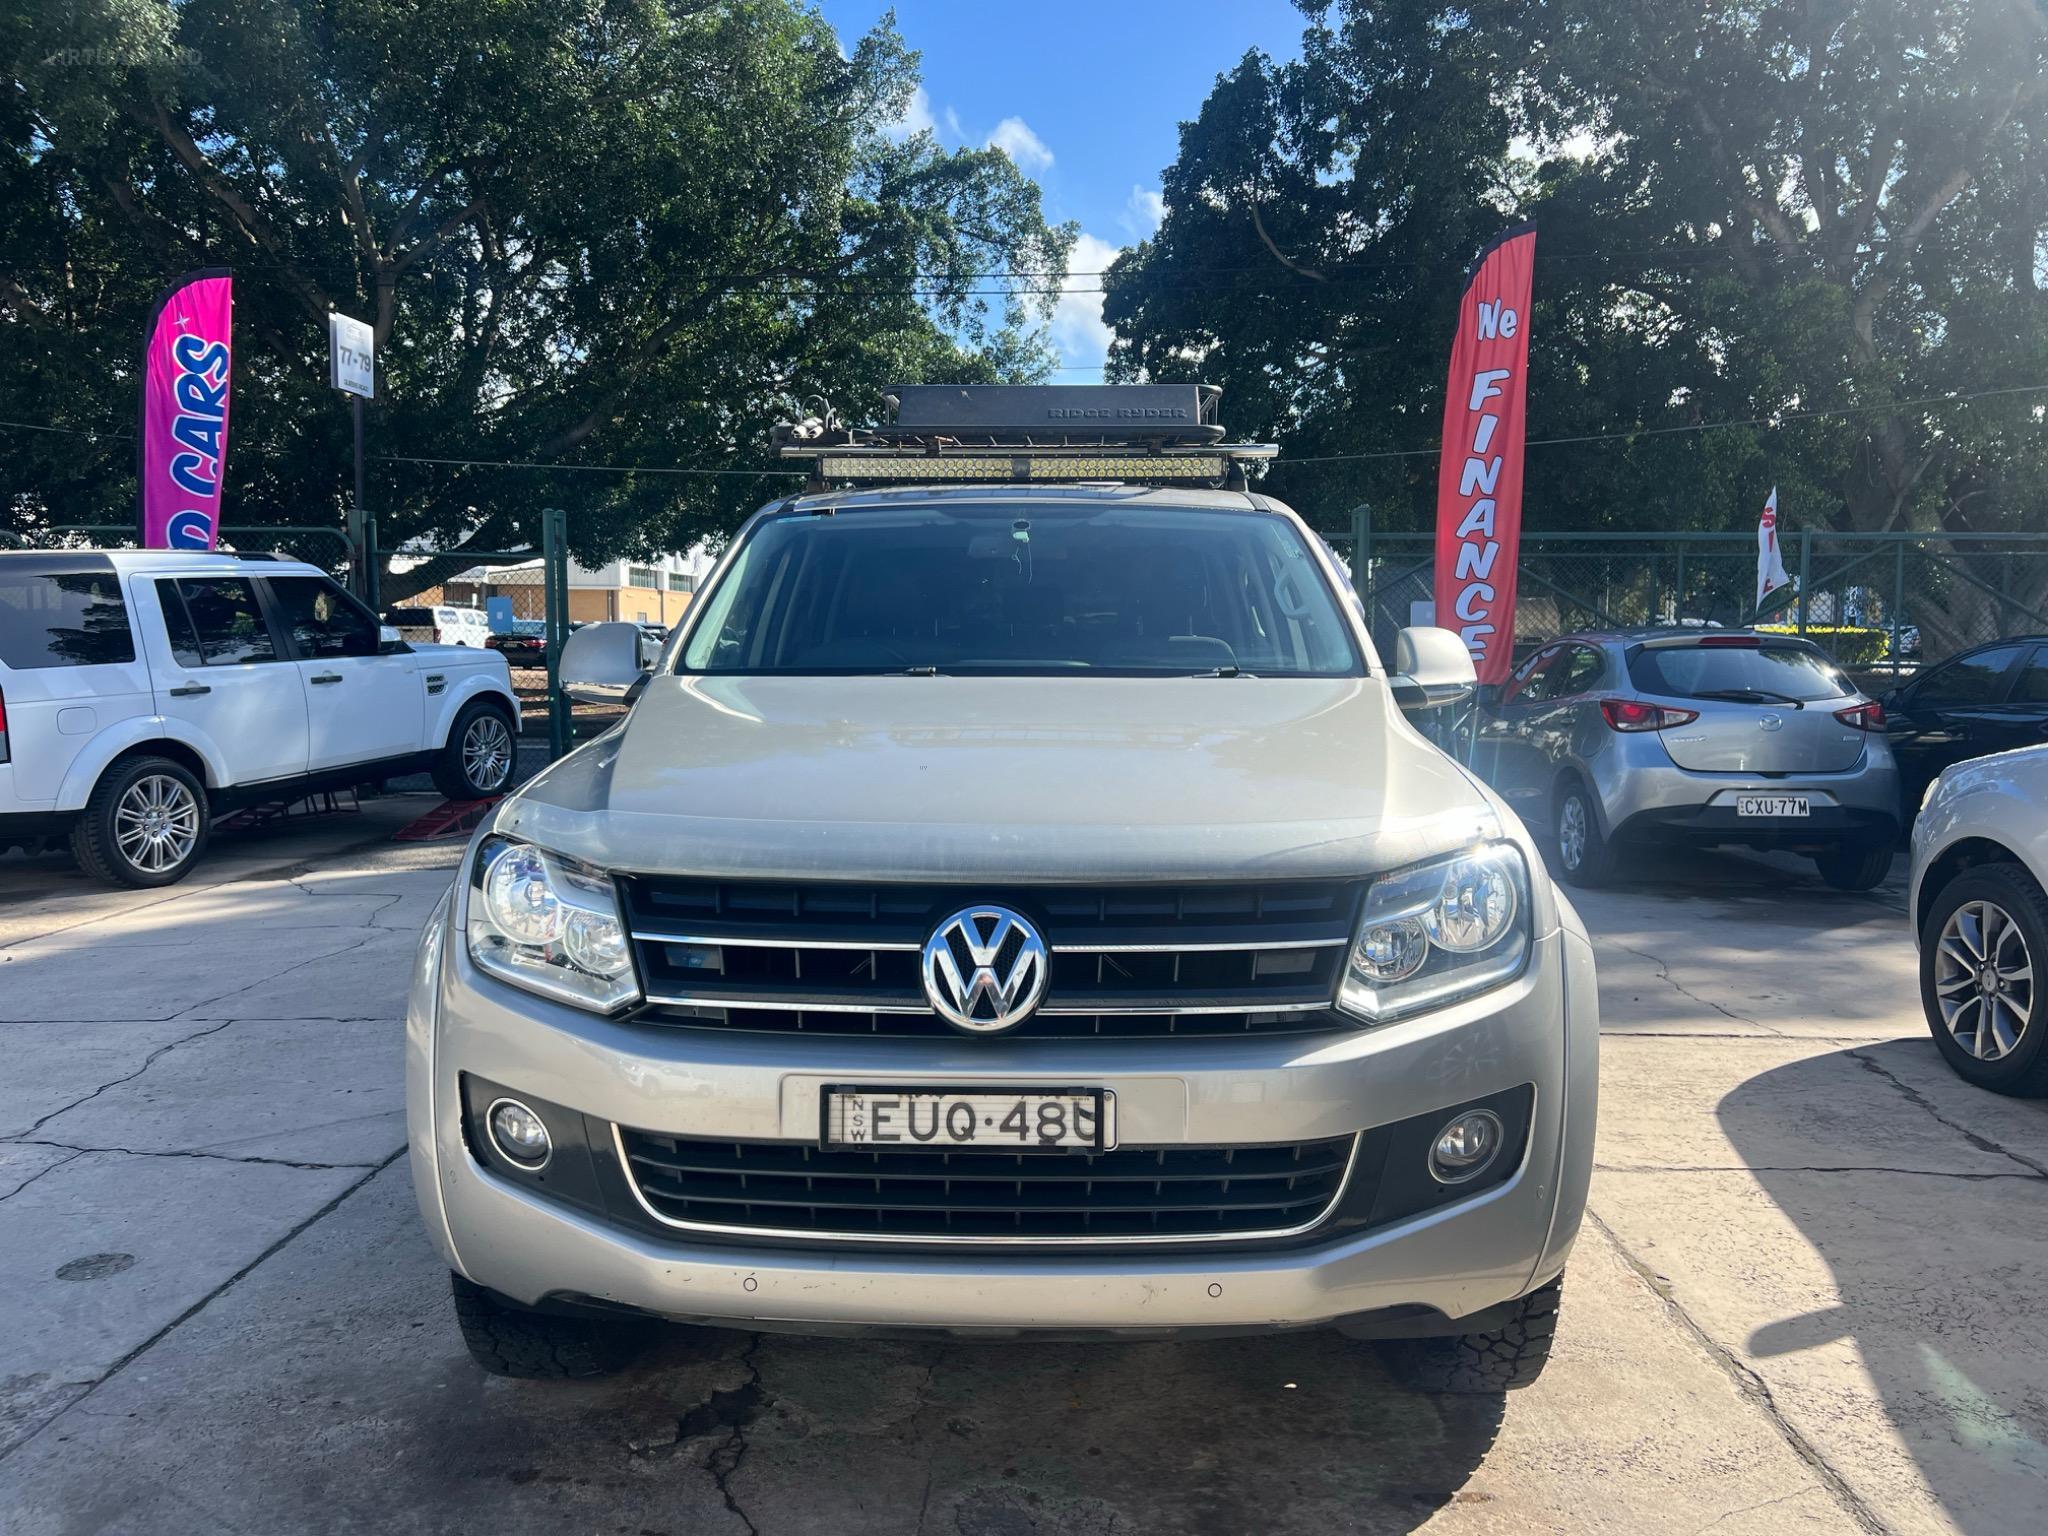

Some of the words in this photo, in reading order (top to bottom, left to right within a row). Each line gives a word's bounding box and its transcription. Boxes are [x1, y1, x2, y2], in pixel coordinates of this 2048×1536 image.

[1476, 297, 1518, 341] We
[170, 333, 229, 498] CARS
[1048, 407, 1111, 419] RIDGE
[1117, 407, 1187, 419] RYDER
[1454, 368, 1511, 661] FINANCE
[851, 1099, 866, 1142] NSW
